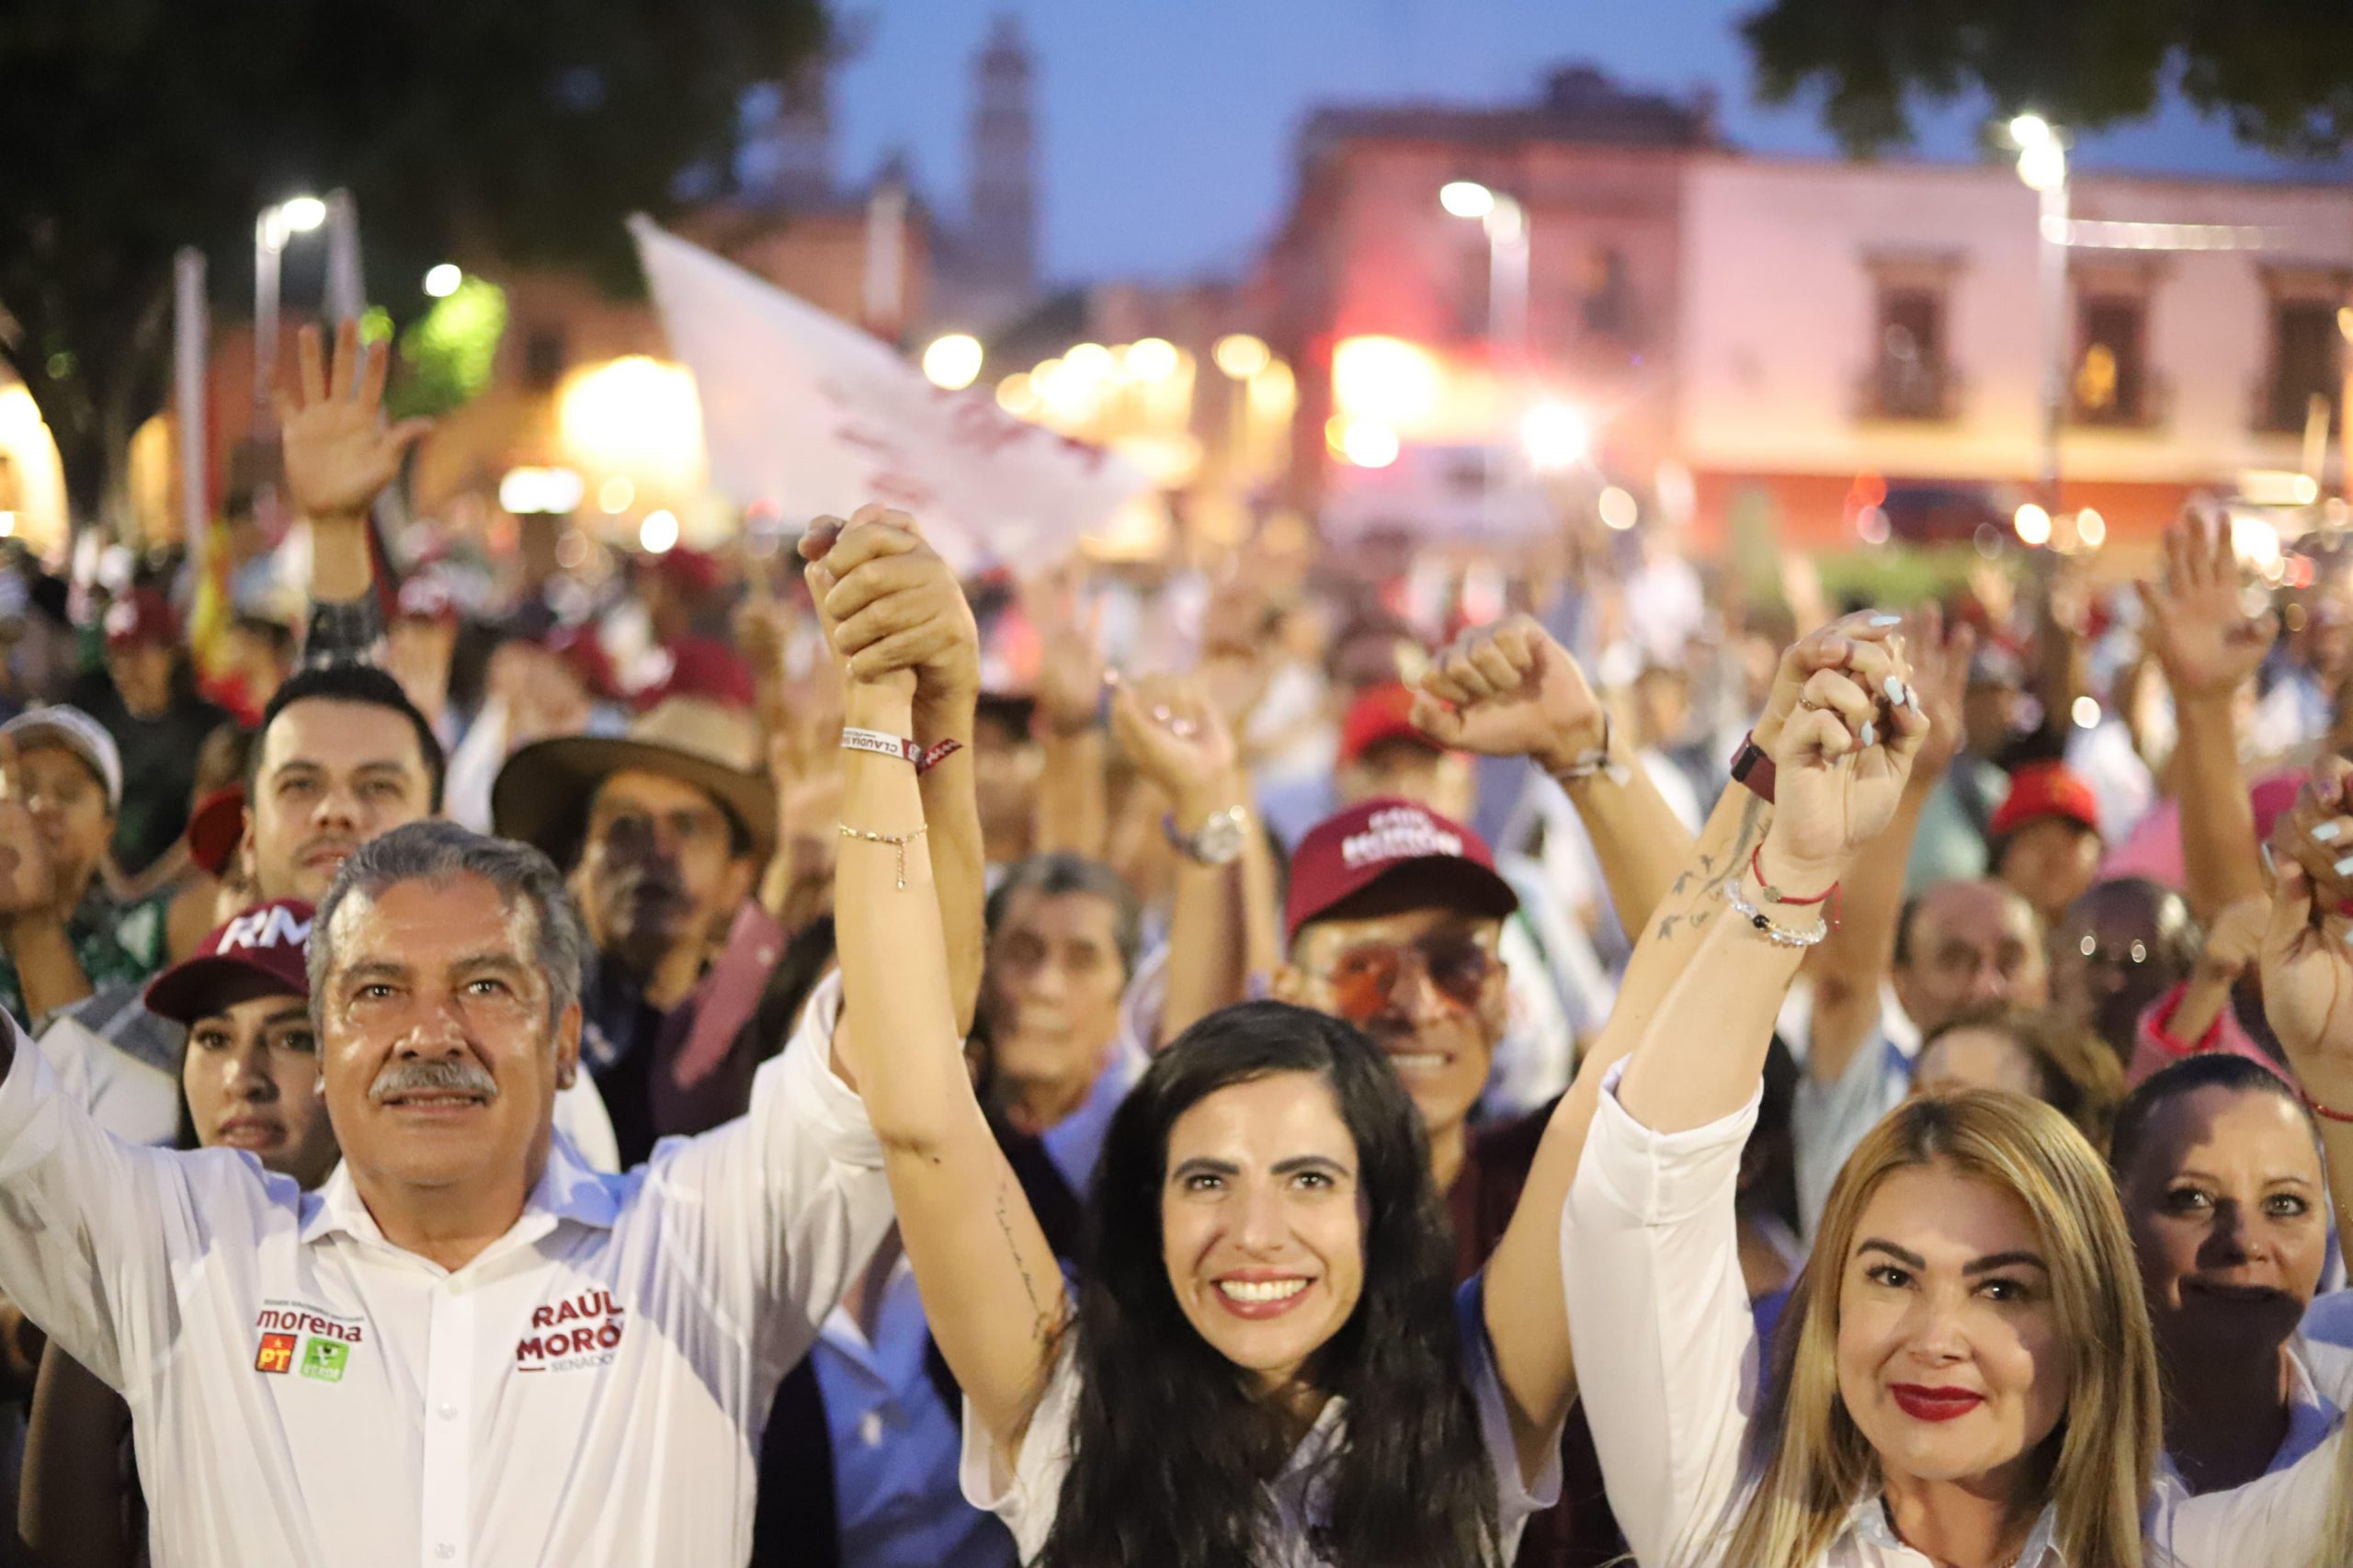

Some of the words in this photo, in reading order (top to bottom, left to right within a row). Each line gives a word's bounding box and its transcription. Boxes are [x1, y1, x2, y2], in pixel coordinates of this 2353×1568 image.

[851, 736, 898, 753] CLAUDIA
[215, 904, 313, 956] RM
[256, 1309, 363, 1343] morena
[531, 1288, 624, 1329] RAÚL
[516, 1318, 622, 1361] MORÓ
[258, 1346, 291, 1371] PT
